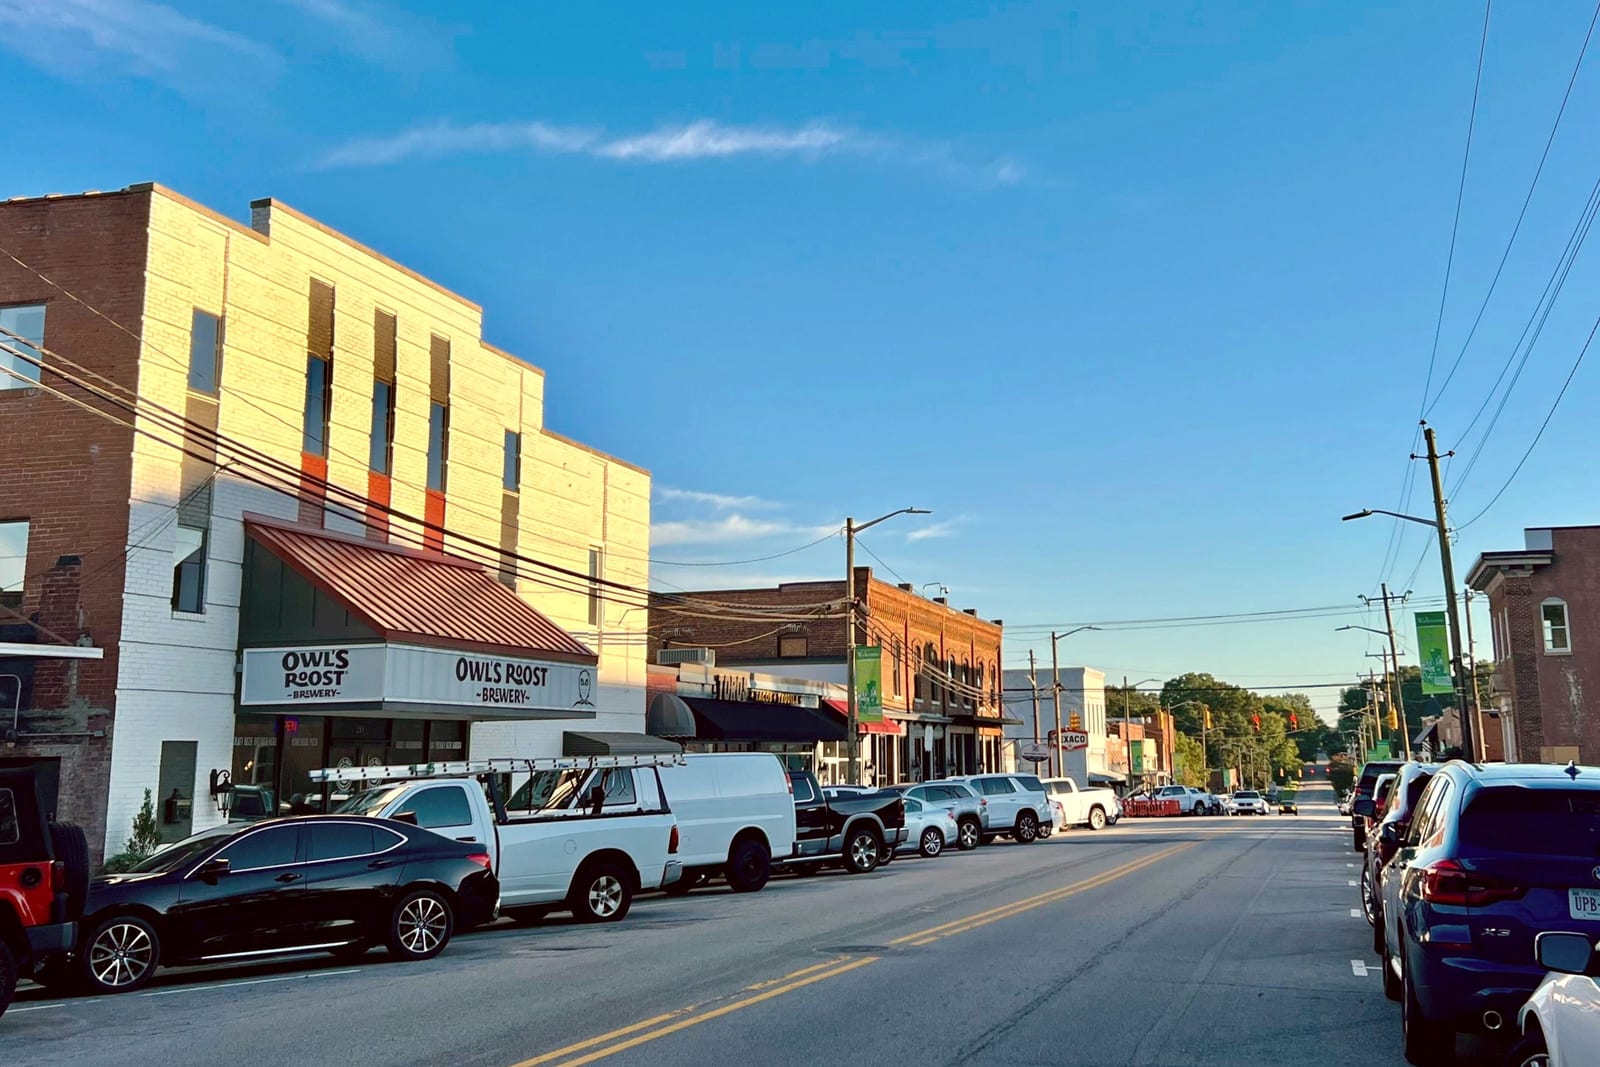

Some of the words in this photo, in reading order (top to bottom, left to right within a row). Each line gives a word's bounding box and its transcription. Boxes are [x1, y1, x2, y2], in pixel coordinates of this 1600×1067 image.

[282, 649, 349, 671] OWL'S
[284, 670, 345, 688] ROOST
[456, 657, 502, 683] OWL'S
[505, 663, 548, 686] ROOST
[719, 674, 749, 702] TOROS
[755, 691, 773, 702] TACOS
[1060, 735, 1086, 744] EXACO
[1481, 927, 1511, 937] X3
